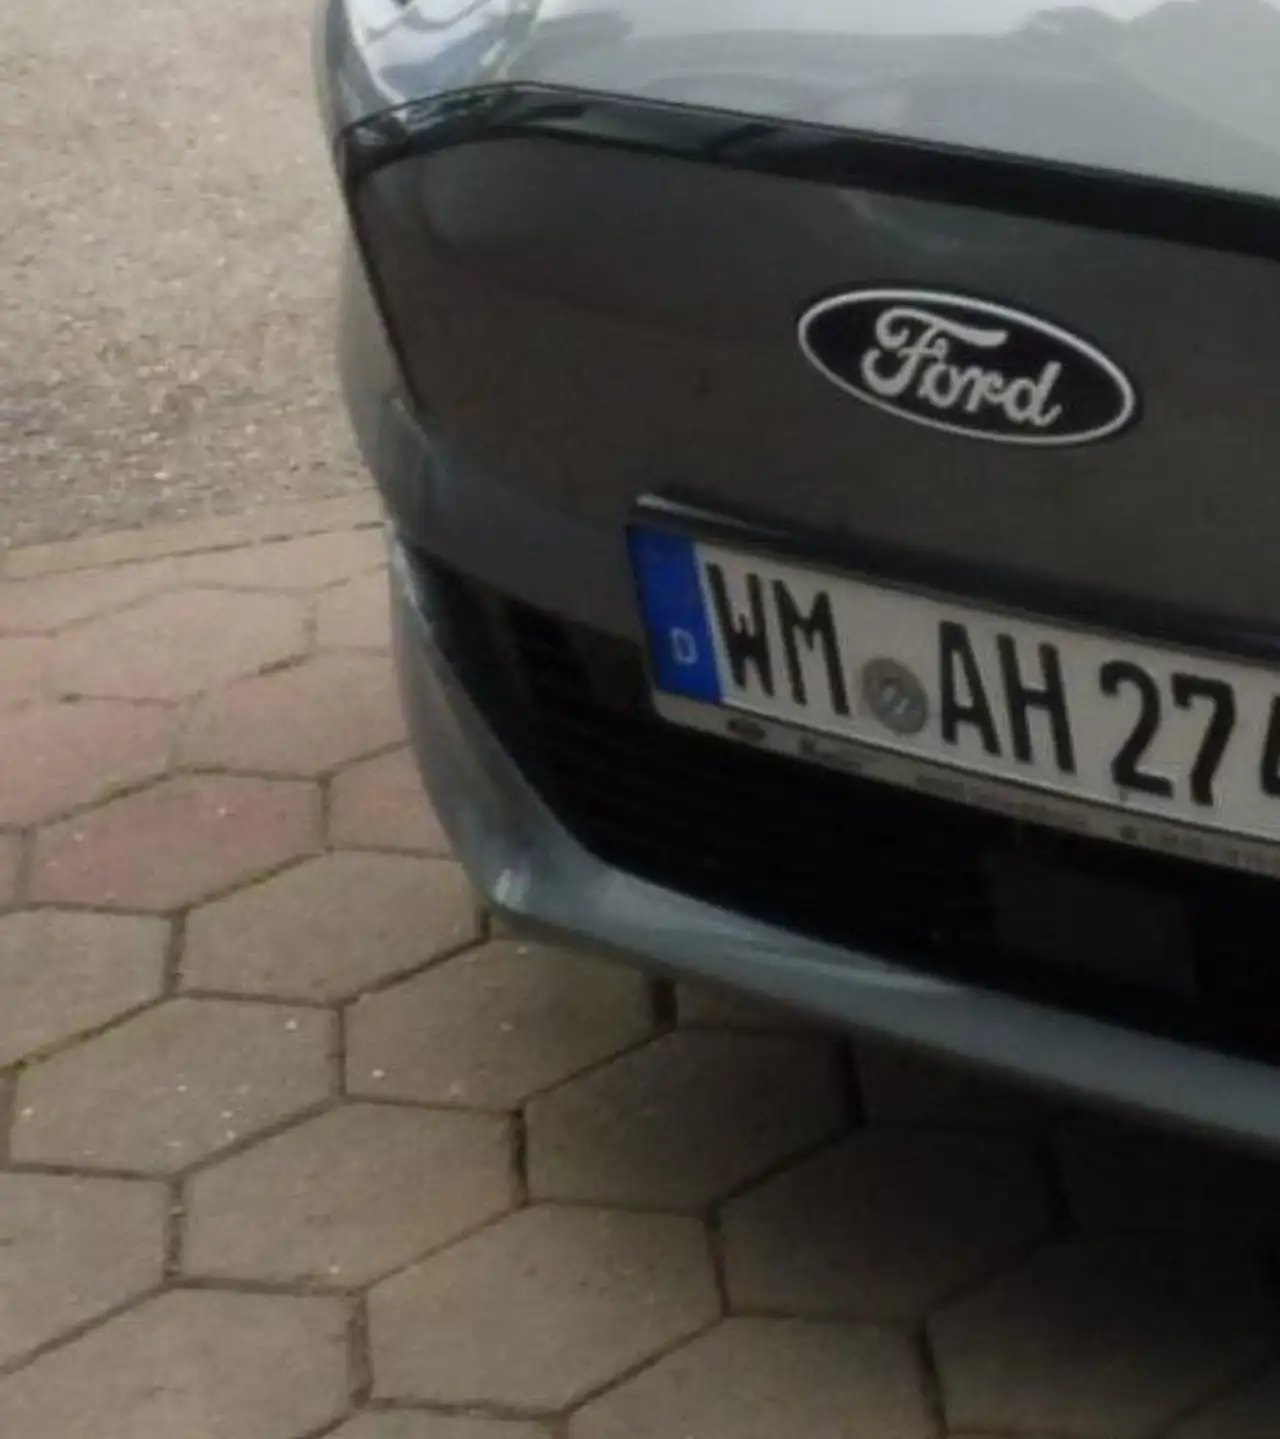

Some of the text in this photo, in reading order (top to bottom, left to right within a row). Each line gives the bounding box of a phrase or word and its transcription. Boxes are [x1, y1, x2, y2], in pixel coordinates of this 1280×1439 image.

[859, 306, 1064, 429] Ford
[669, 626, 699, 667] D
[705, 562, 851, 716] WM
[938, 620, 1077, 774] AH
